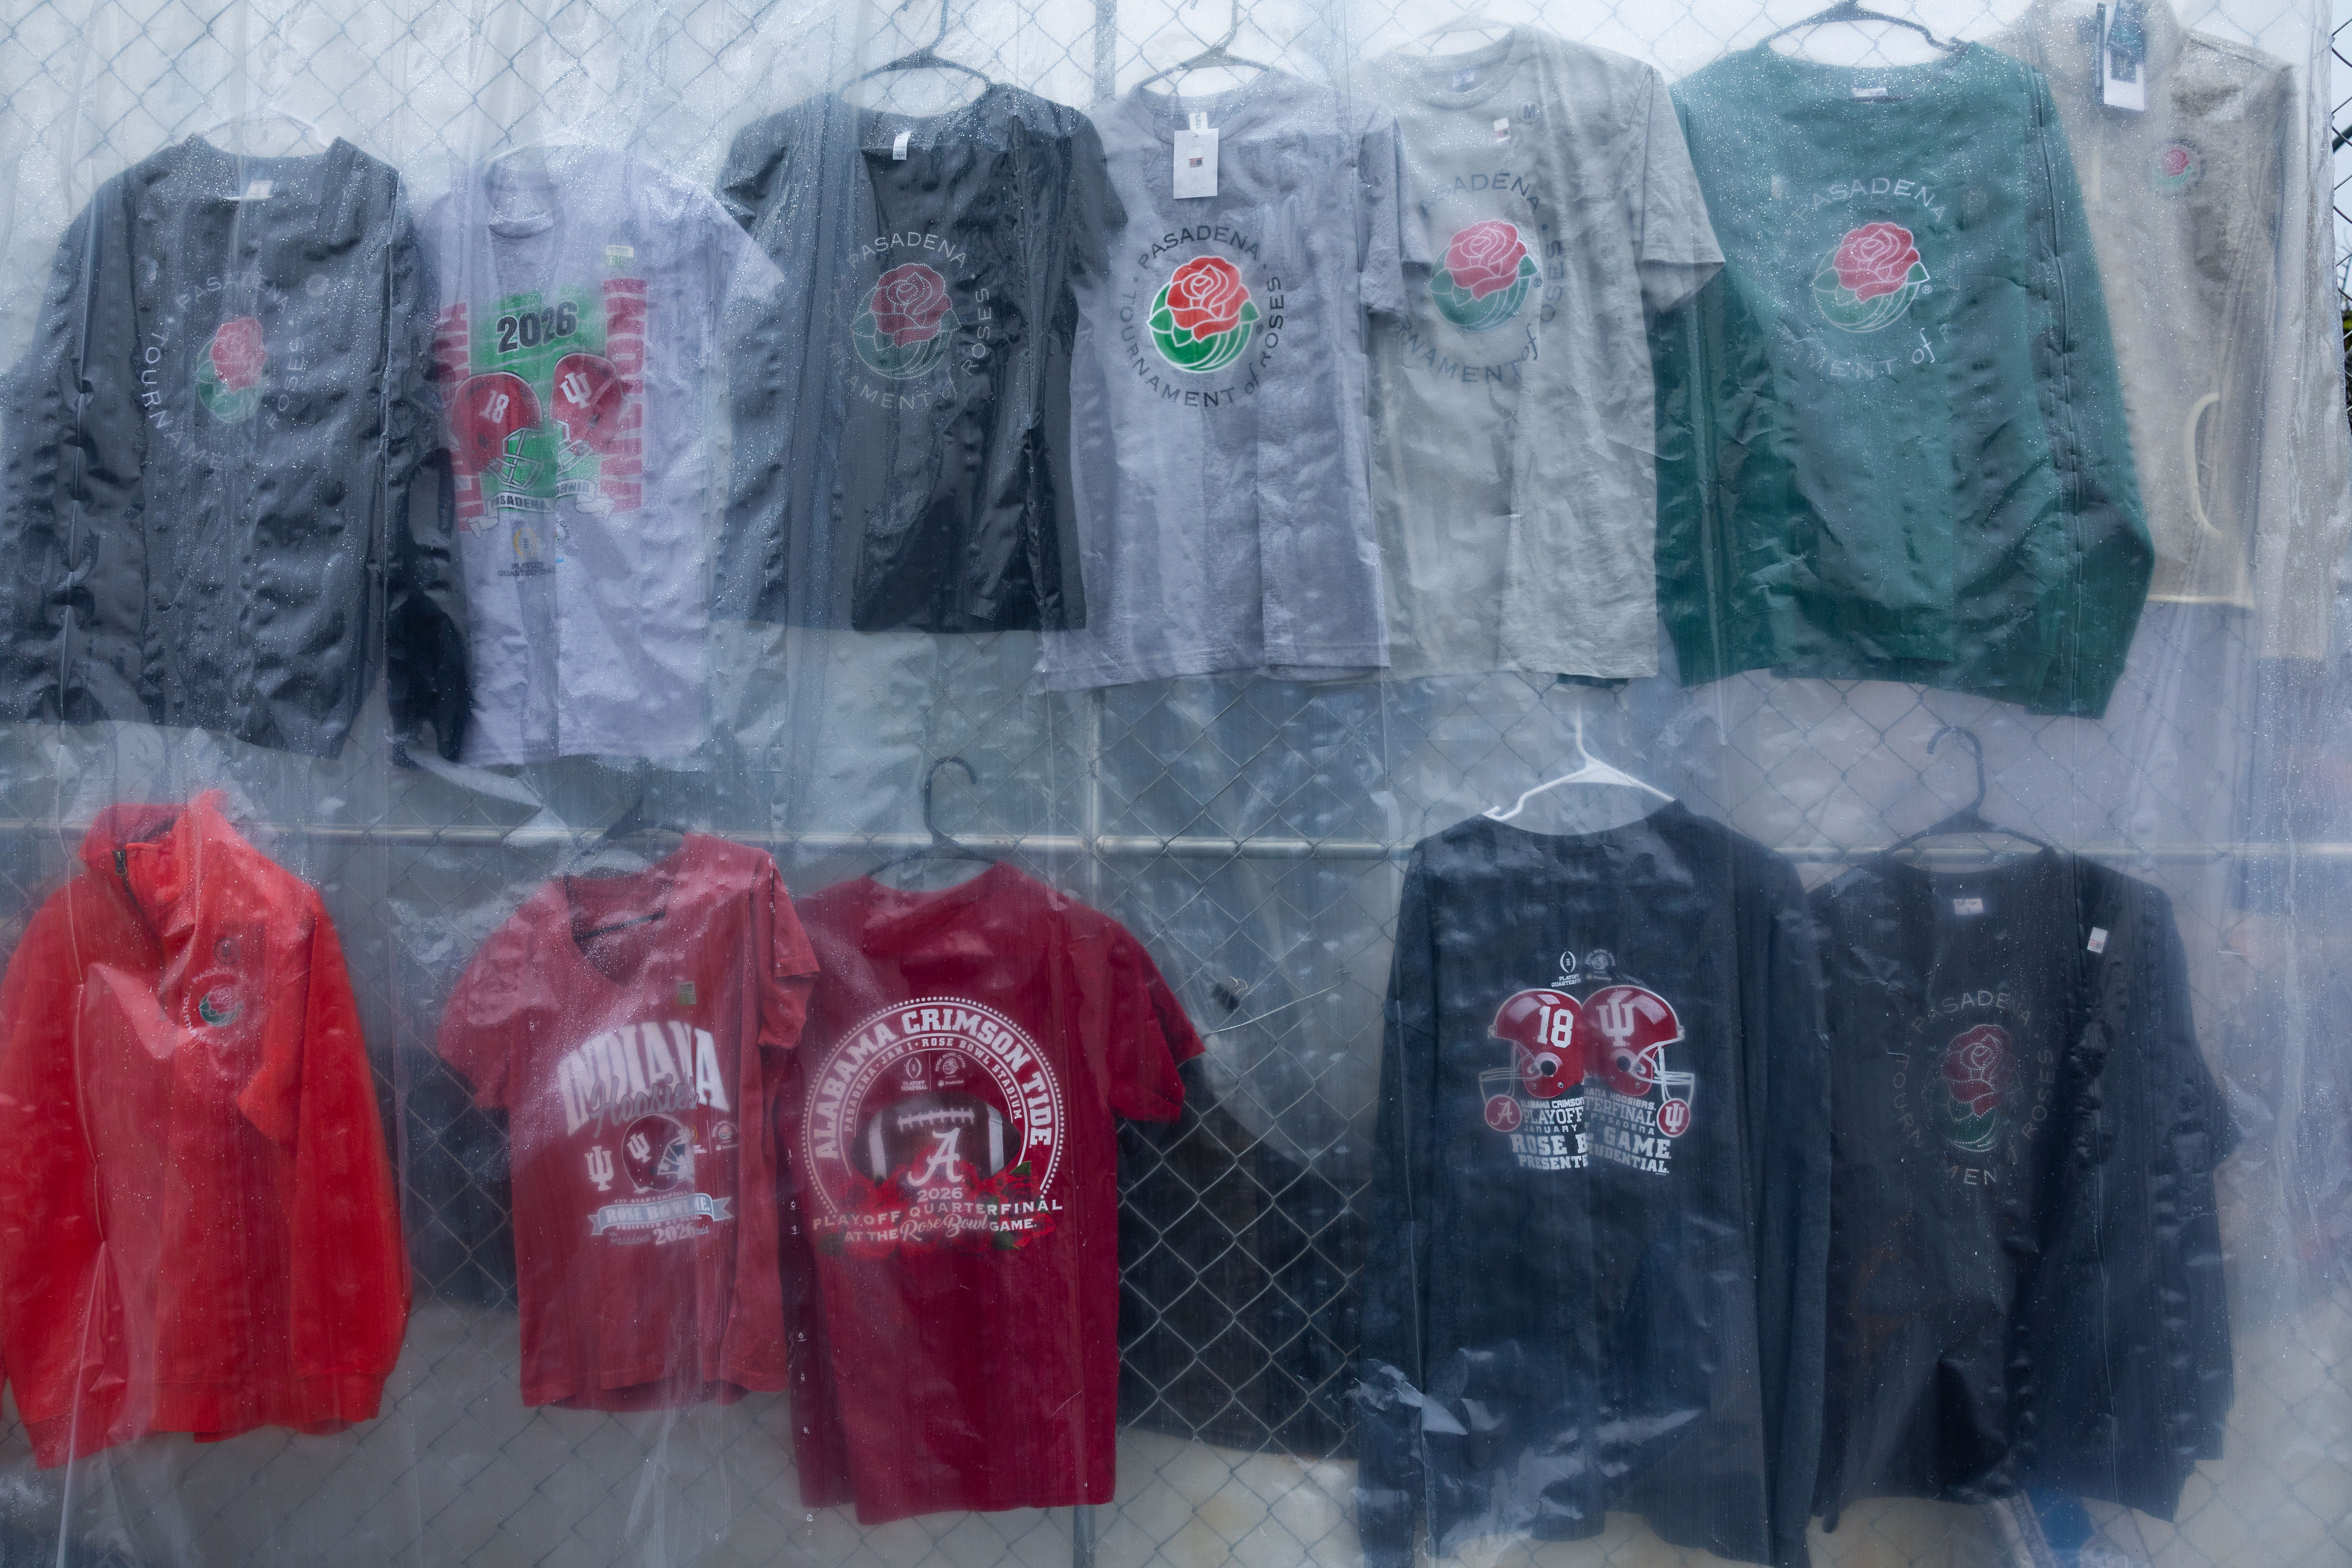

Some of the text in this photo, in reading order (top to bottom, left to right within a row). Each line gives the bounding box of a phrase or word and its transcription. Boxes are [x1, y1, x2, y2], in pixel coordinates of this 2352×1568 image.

[1524, 104, 1535, 118] M
[847, 232, 966, 269] PASADENA
[961, 288, 992, 376] ROSES
[1521, 323, 1539, 361] of
[1540, 240, 1564, 323] OSES
[496, 300, 579, 354] 2026
[1120, 225, 1285, 407] PASADENA TOURNAMENT of ROSES
[1912, 328, 1935, 364] of
[142, 332, 227, 470] TOURNAME
[267, 337, 305, 430] ROSES
[479, 390, 510, 424] 18
[490, 495, 548, 510] PASADENA
[497, 568, 556, 577] QUARTERNAL
[191, 967, 236, 984] PASADE
[1551, 978, 1582, 987] QUARTERFIN
[1559, 973, 1579, 982] PLAYOFF
[1537, 1005, 1574, 1049] 18
[935, 1058, 944, 1072] ROSE
[957, 1054, 966, 1069] GAME
[814, 1008, 1053, 1159] ALABAMA CRIMSON TIDE
[844, 1037, 1023, 1132] PASADENA JAN 1 ROSE BOWL STADIUM
[1521, 1099, 1550, 1109] ALABAMA
[1551, 1096, 1585, 1109] CRIMSON
[1522, 1096, 1655, 1127] PLAYOFF TERFINAL
[1524, 1112, 1654, 1136] JANUARY PASADENA
[1510, 1134, 1568, 1156] ROSE
[1604, 1125, 1671, 1160] GAME.
[1517, 1142, 1670, 1174] PRESENTE RUDENTIAL.
[916, 1187, 963, 1203] 2026
[606, 1206, 643, 1223] ROSE
[647, 1200, 689, 1221] BOWL
[617, 1222, 662, 1230] PRESENTED
[813, 1199, 1063, 1230] PLAYOFF QUARTERFINAL
[653, 1221, 695, 1245] 2026
[844, 1214, 1037, 1242] AT THE Rose Bowl GAME.
